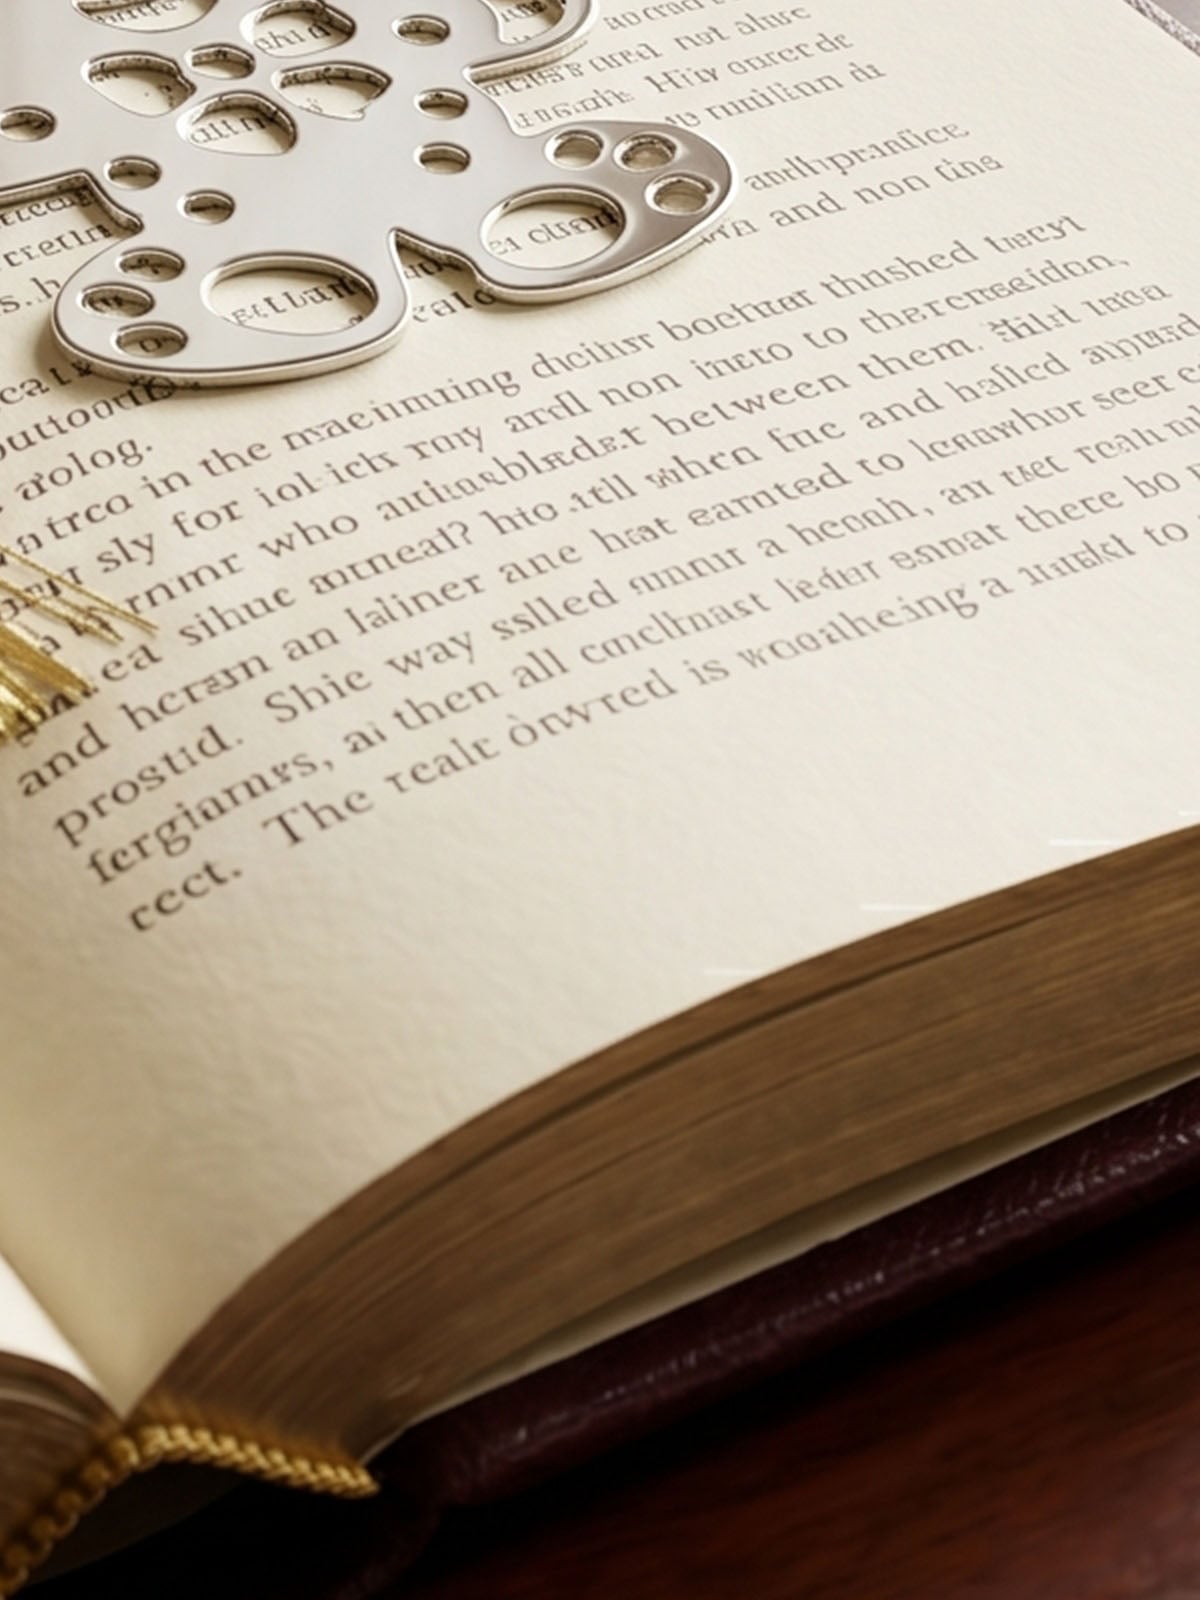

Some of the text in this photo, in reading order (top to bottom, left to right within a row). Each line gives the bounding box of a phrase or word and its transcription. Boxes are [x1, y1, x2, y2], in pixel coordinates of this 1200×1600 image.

[768, 190, 847, 228] and
[95, 532, 155, 574] sly
[171, 499, 244, 539] for
[801, 327, 849, 350] to
[140, 471, 192, 500] in
[197, 442, 272, 478] the
[257, 514, 360, 558] who
[649, 373, 852, 437] between
[858, 387, 945, 430] and
[17, 720, 111, 798] and
[282, 627, 340, 662] an
[855, 453, 905, 477] to
[384, 631, 475, 676] way
[756, 538, 789, 558] a
[260, 791, 373, 847] The
[687, 659, 731, 686] is
[979, 577, 1015, 599] a
[1143, 522, 1190, 547] to
[392, 681, 501, 731] then
[511, 647, 571, 690] all
